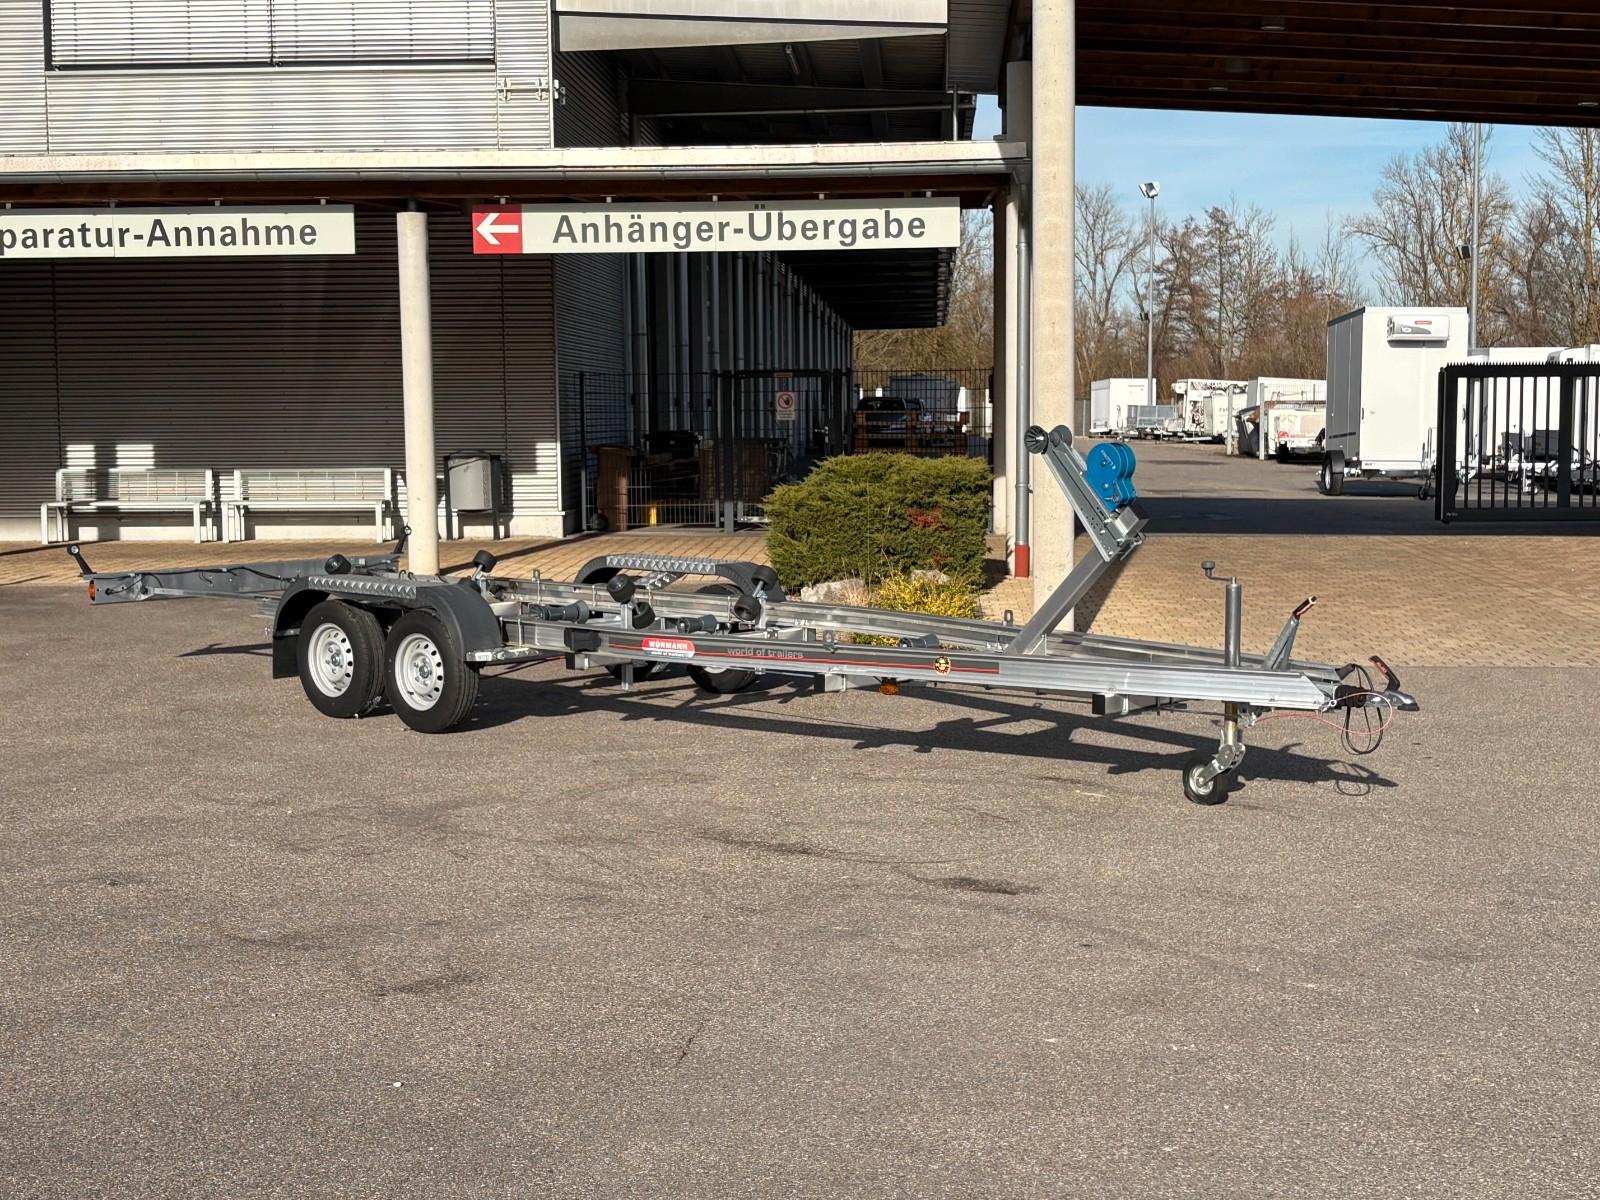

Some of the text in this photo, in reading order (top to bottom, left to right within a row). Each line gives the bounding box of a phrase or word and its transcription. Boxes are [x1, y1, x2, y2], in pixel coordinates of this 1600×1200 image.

[0, 217, 318, 256] paratur-Annahme
[552, 203, 926, 249] Anhänger-Übergabe
[727, 647, 804, 659] world of trailers
